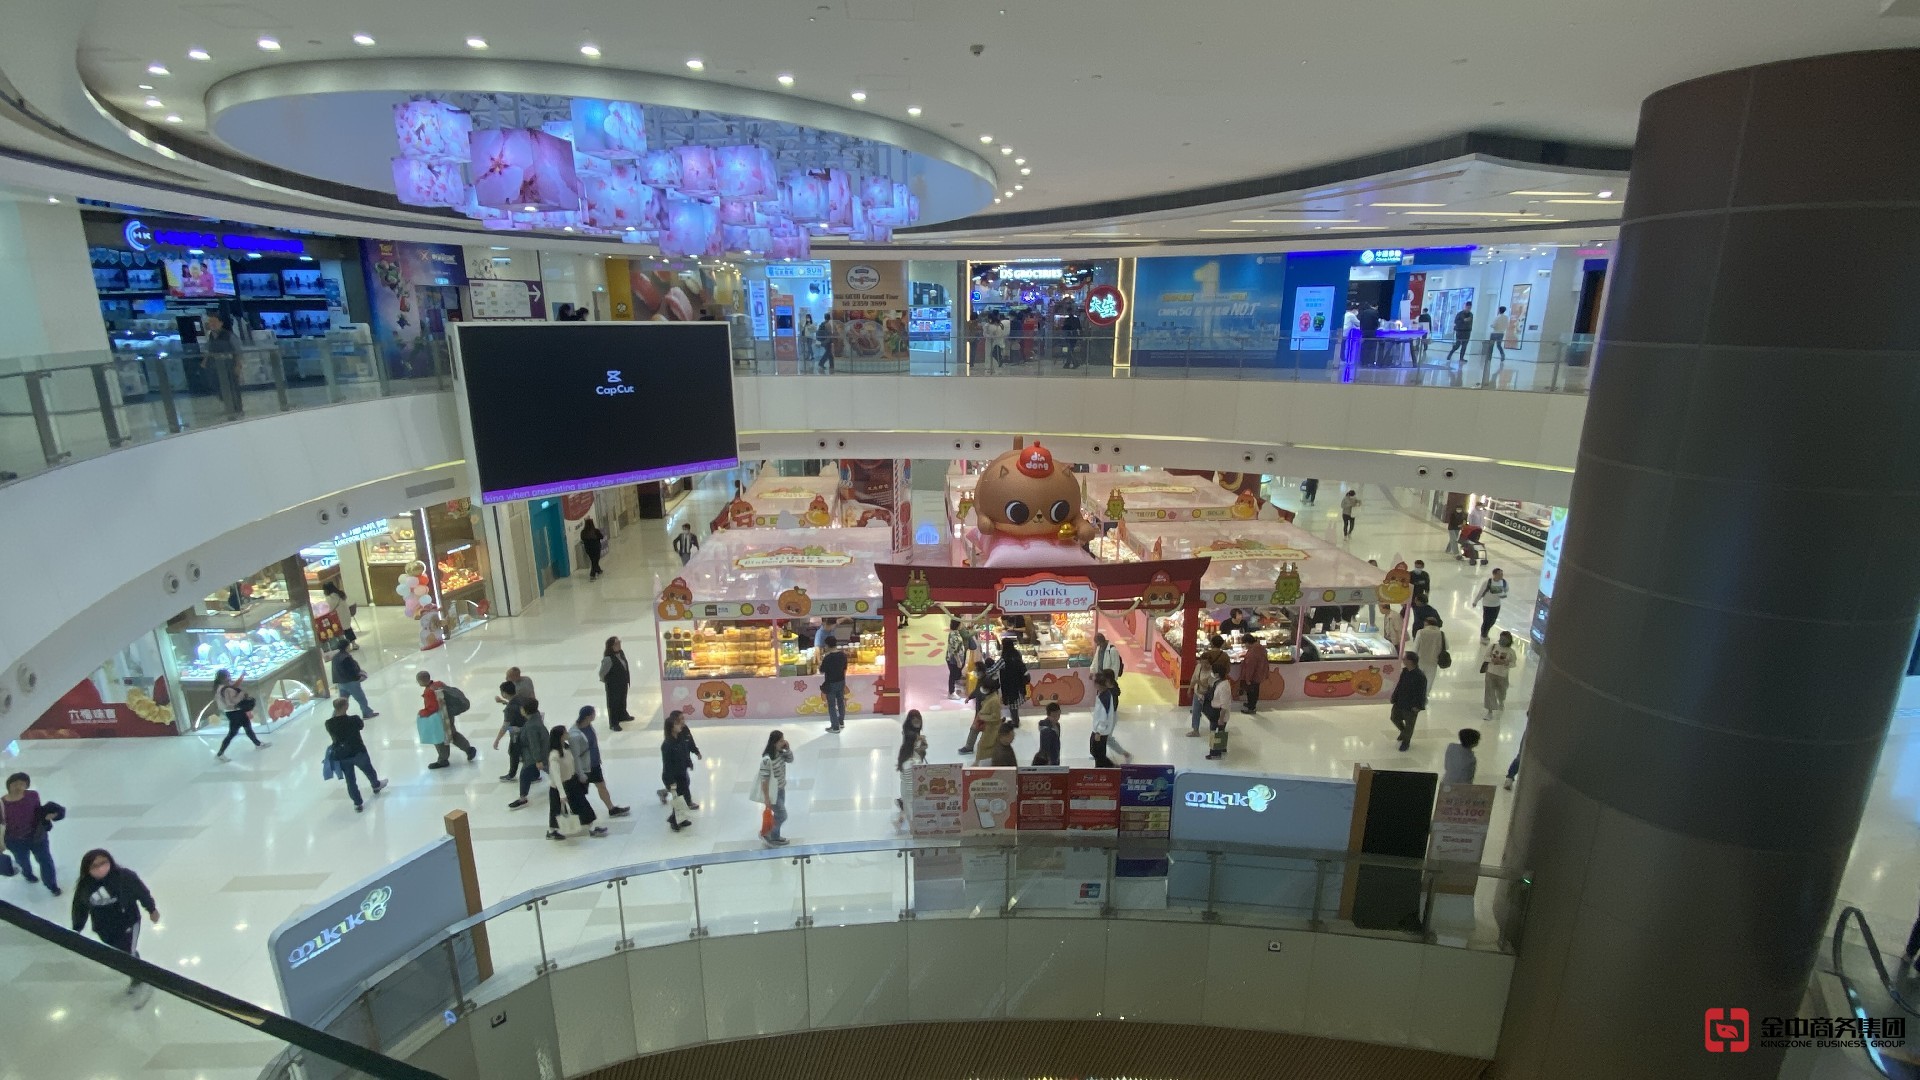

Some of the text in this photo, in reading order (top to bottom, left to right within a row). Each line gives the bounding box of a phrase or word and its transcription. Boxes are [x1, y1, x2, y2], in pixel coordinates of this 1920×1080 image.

[595, 384, 635, 397] CapCut
[1030, 451, 1046, 462] din
[1025, 460, 1049, 471] dong
[506, 488, 530, 500] when
[532, 483, 576, 498] presenting
[1504, 518, 1542, 537] GIORDANO
[1025, 587, 1068, 597] mikiki
